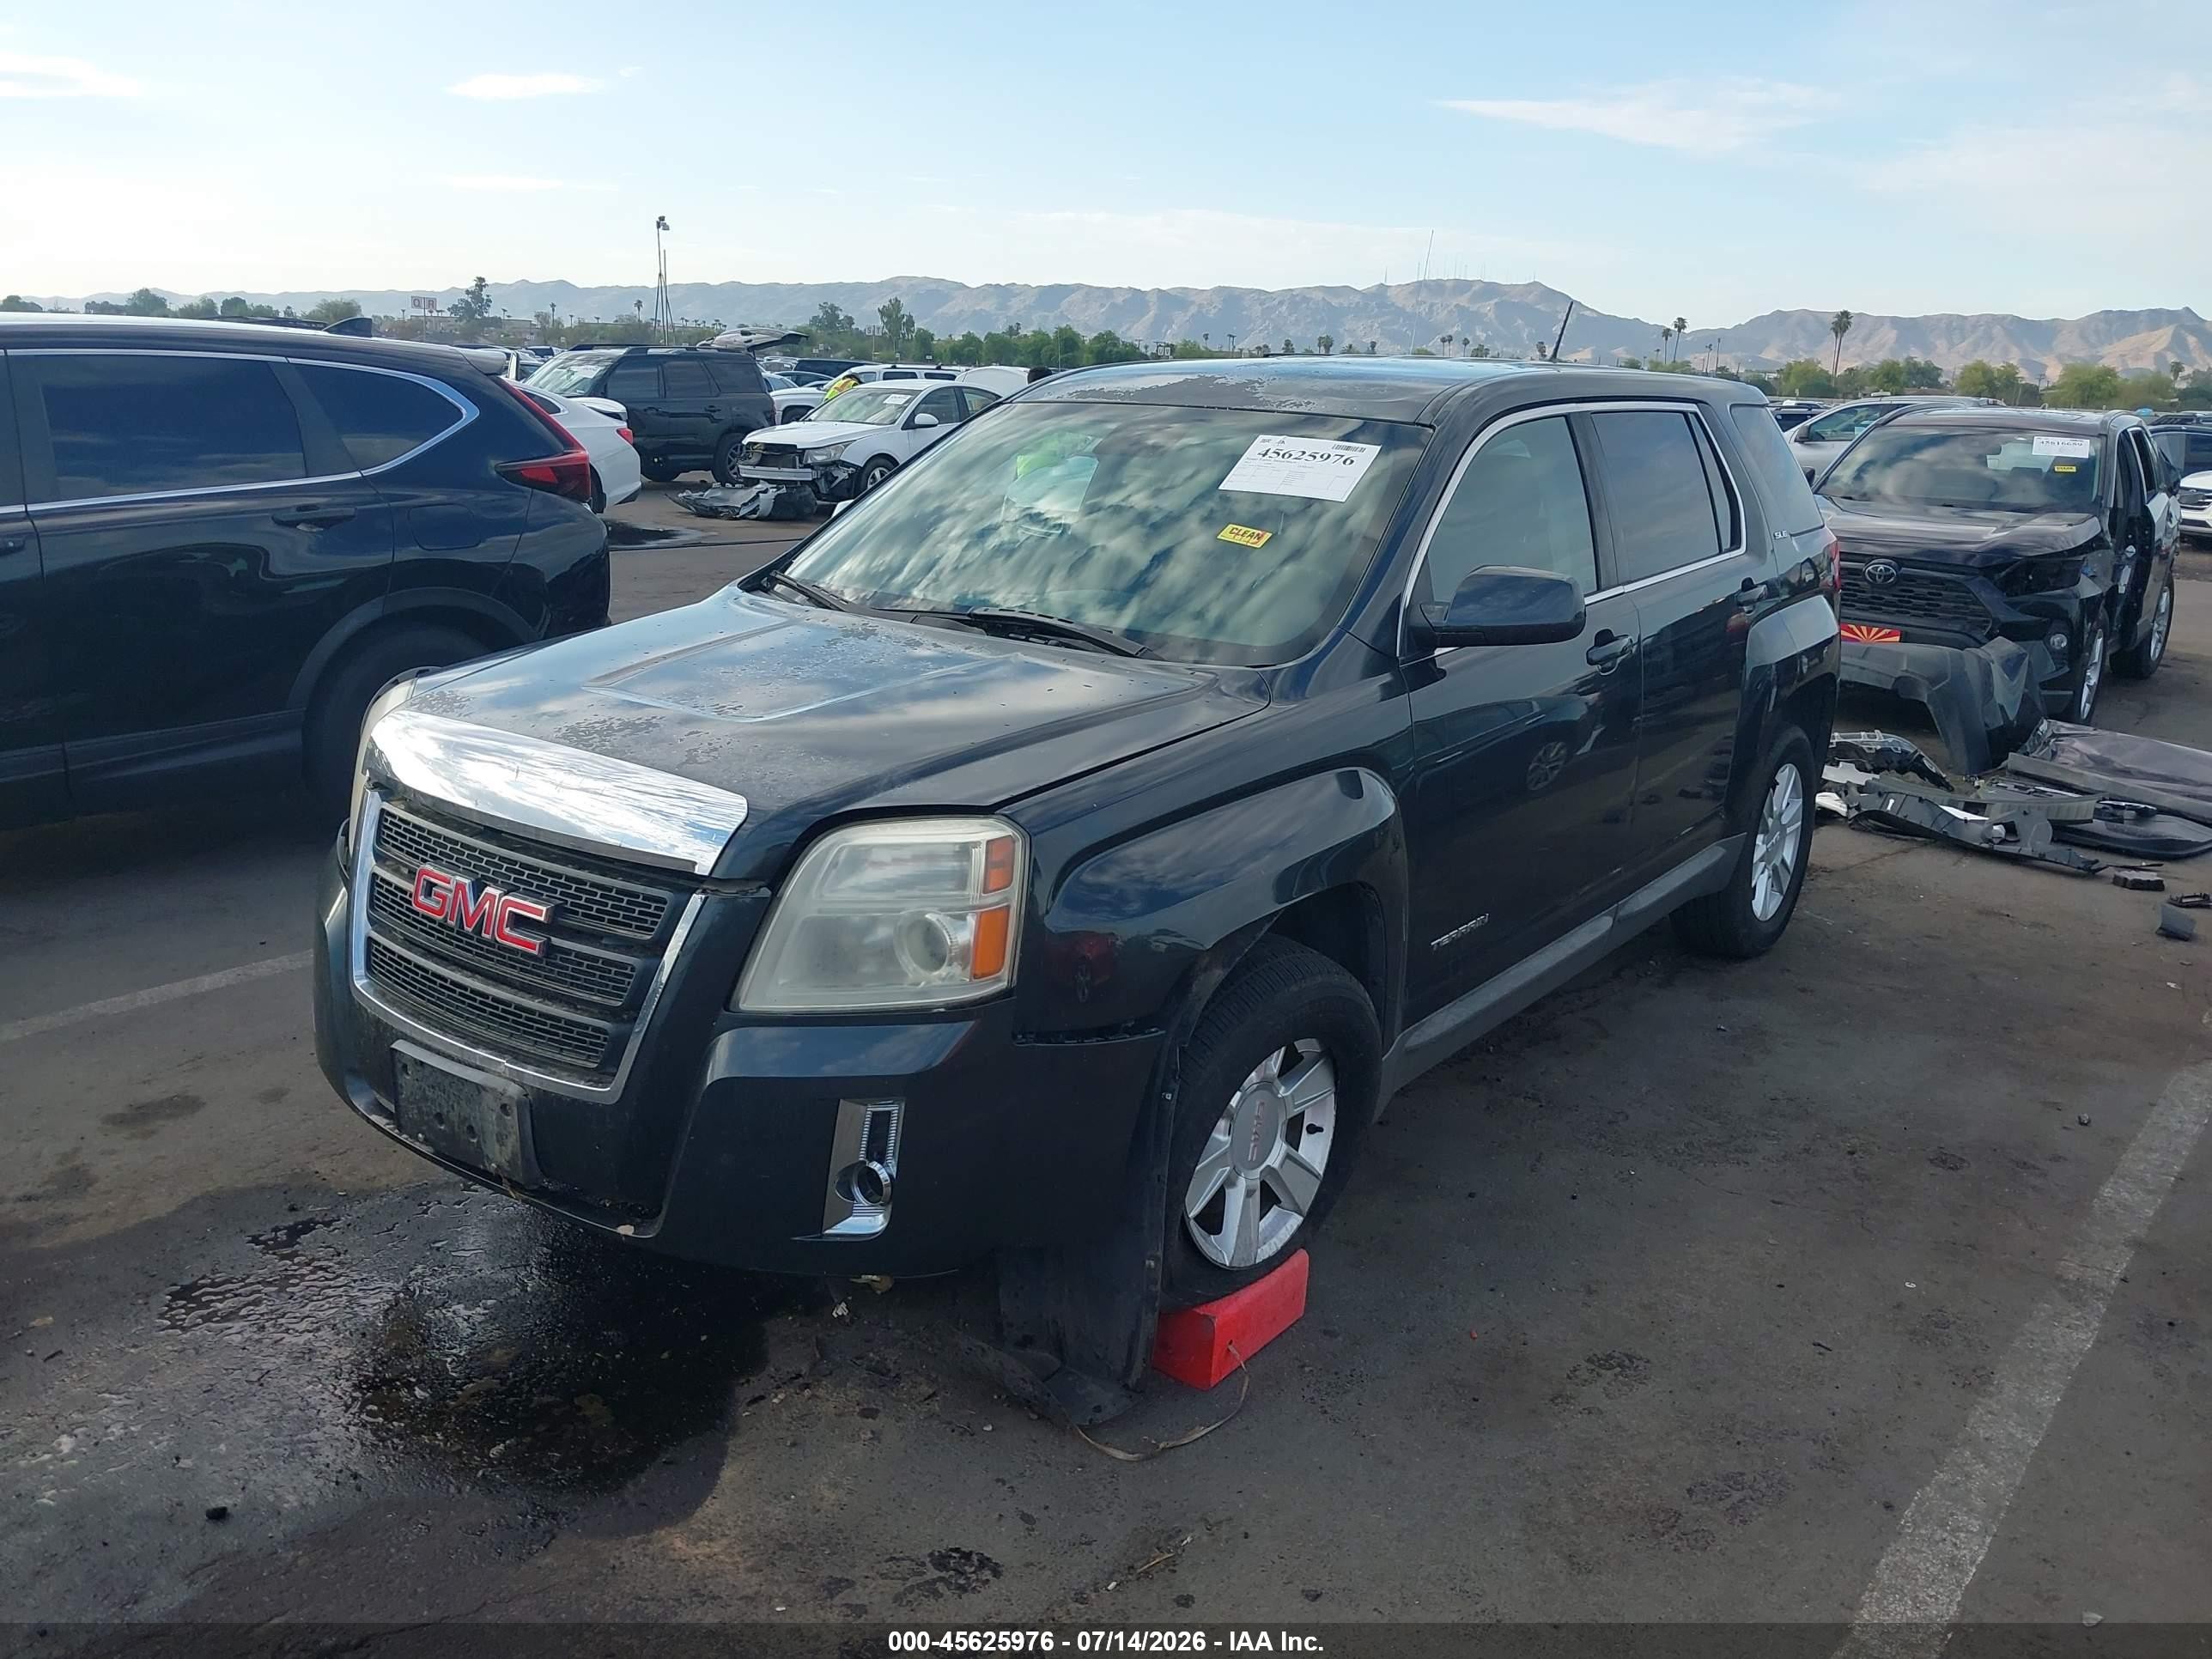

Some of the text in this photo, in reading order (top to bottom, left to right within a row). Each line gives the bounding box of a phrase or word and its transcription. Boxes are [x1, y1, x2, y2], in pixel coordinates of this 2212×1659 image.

[412, 298, 421, 308] Q
[1257, 447, 1357, 467] 45625976
[1229, 526, 1264, 541] CLEAN
[412, 862, 555, 956] GMC
[1431, 913, 1489, 951] TERRAIN
[1248, 1100, 1265, 1162] GMC
